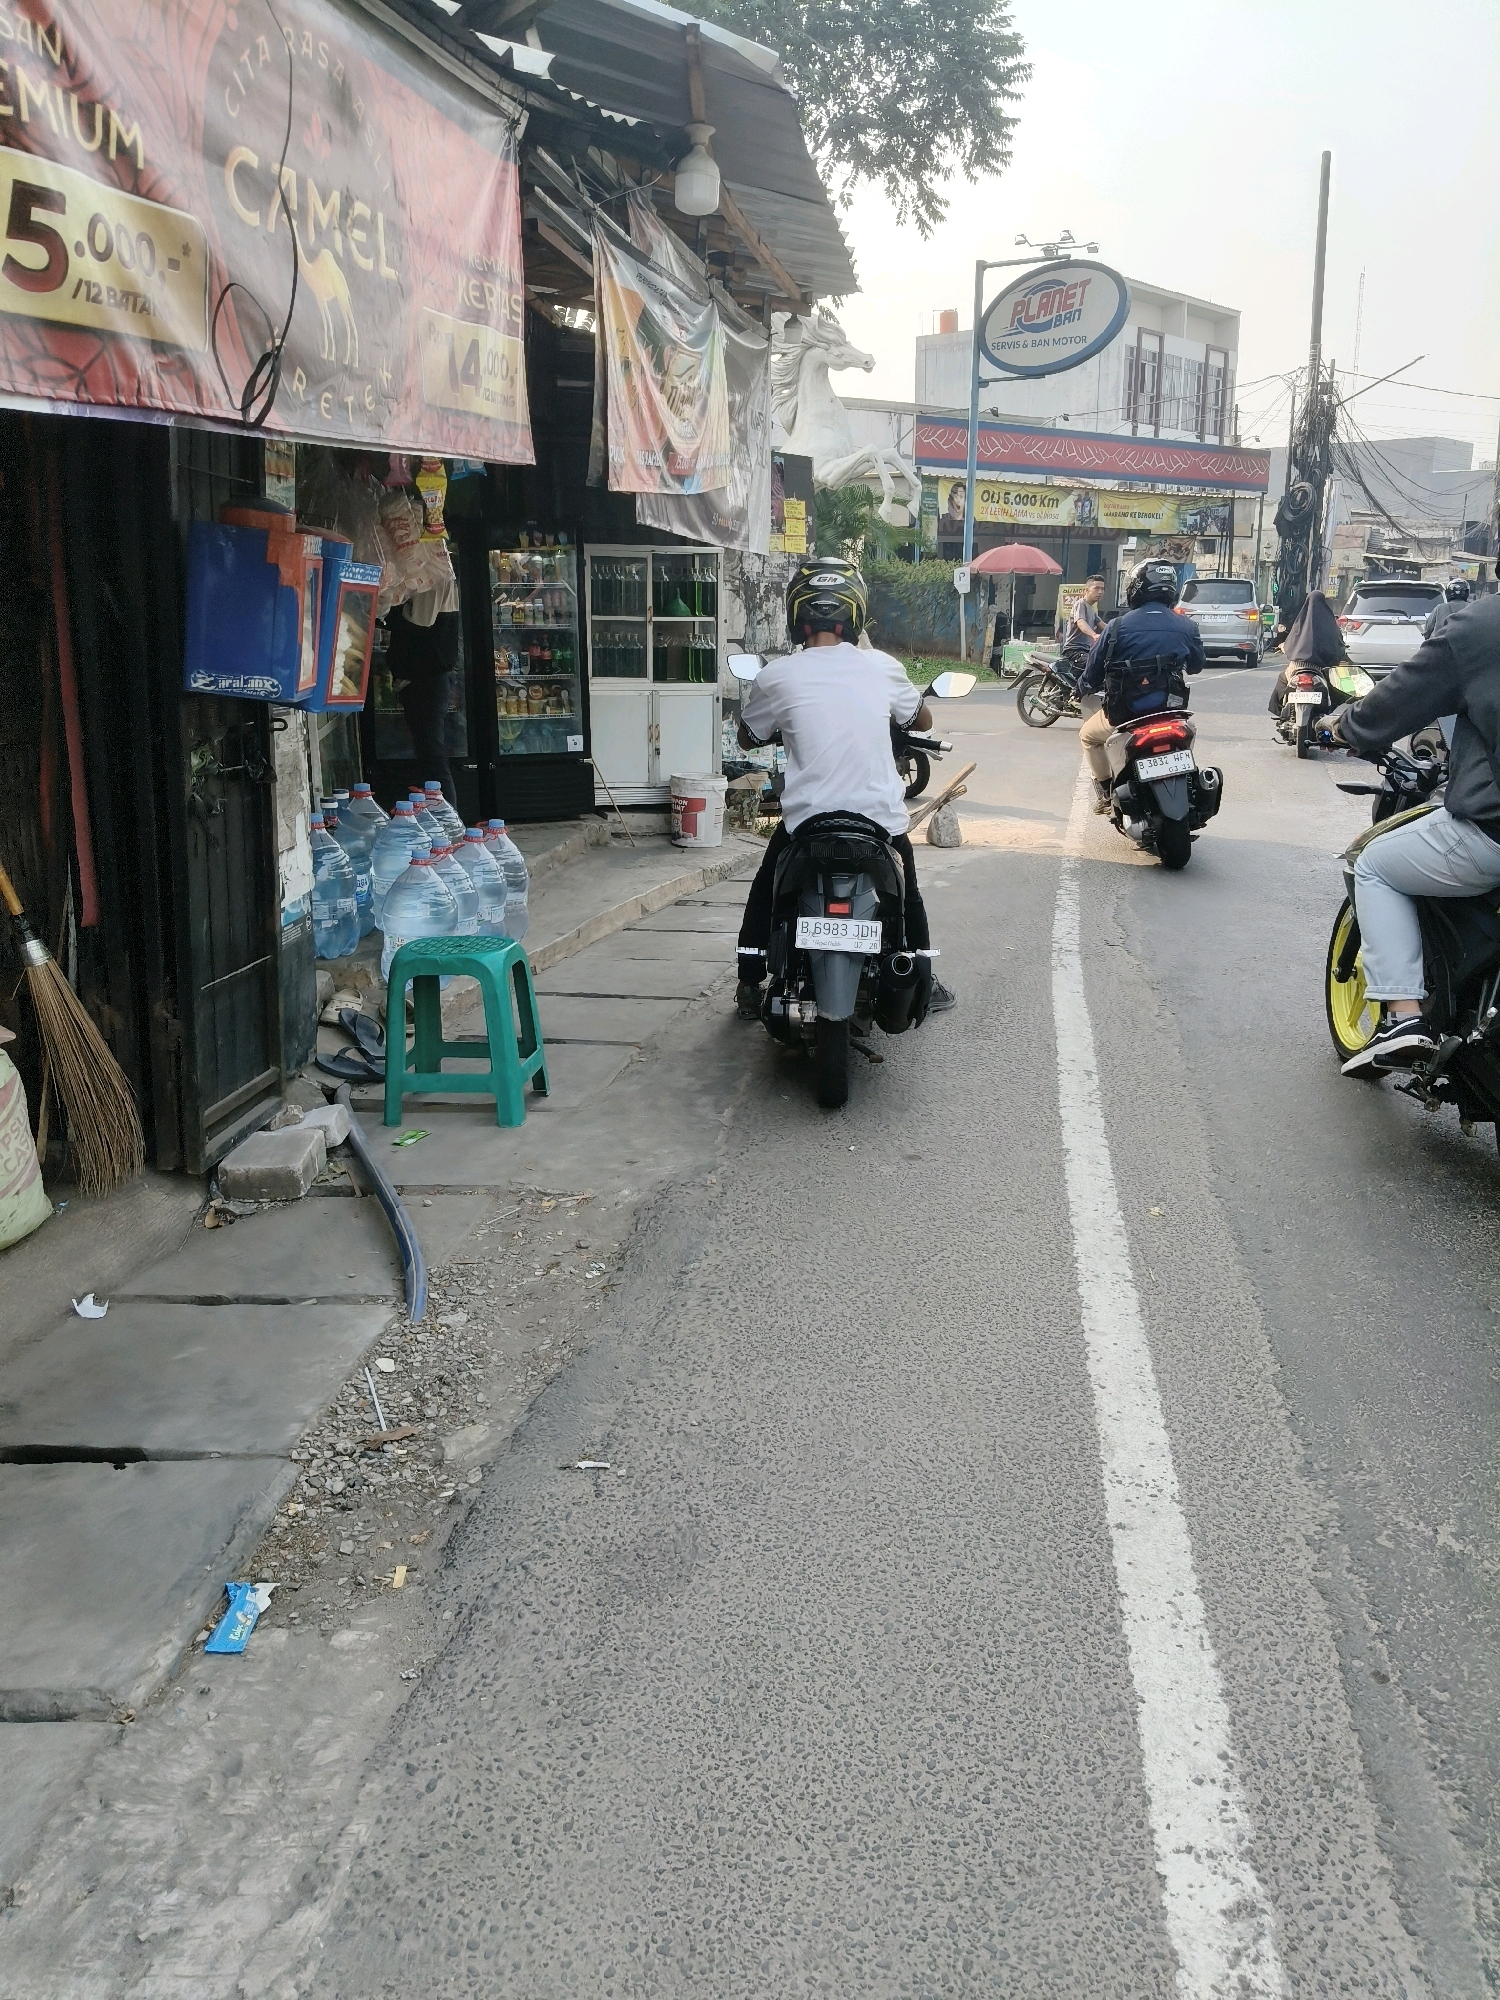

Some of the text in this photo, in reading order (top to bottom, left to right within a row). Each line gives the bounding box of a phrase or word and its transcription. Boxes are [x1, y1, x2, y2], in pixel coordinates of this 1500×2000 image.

[224, 146, 399, 281] CAMEL
[1010, 278, 1092, 328] PLANET
[1053, 308, 1082, 329] BAN
[991, 335, 1088, 351] SERVIS & BAN MOTOR
[980, 490, 1060, 509] OLI 5.000 Km
[1009, 508, 1028, 518] LAMA
[1138, 761, 1145, 770] B
[800, 921, 878, 938] B 6983 JDH
